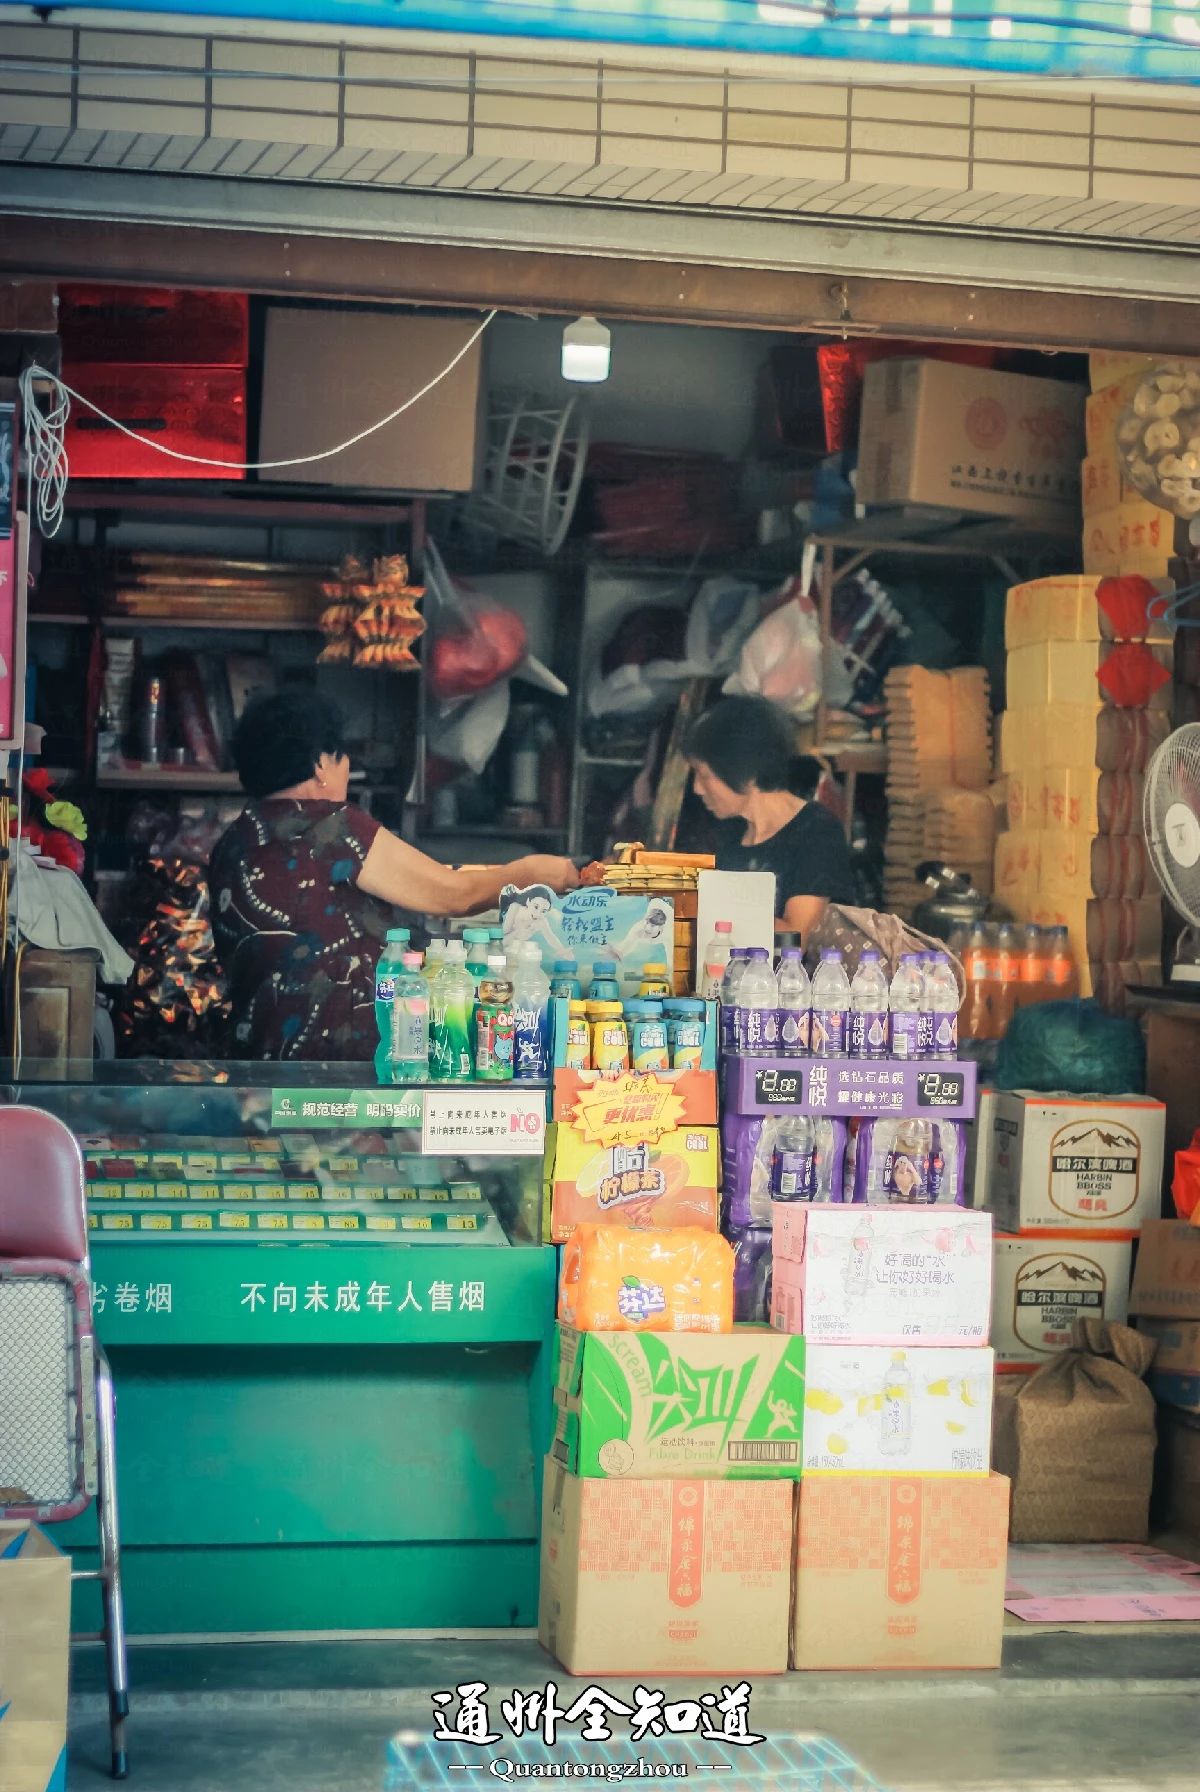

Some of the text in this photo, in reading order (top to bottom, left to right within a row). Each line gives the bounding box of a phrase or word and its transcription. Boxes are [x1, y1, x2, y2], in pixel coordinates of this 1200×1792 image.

[808, 1065, 828, 1107] 纯悦
[302, 1102, 421, 1118] 规范经营 明码实价
[1056, 1157, 1133, 1171] 哈尔滨啤酒
[240, 1280, 486, 1313] 不向未成年人售烟
[618, 1285, 666, 1312] 芬达
[608, 1335, 653, 1398] scream
